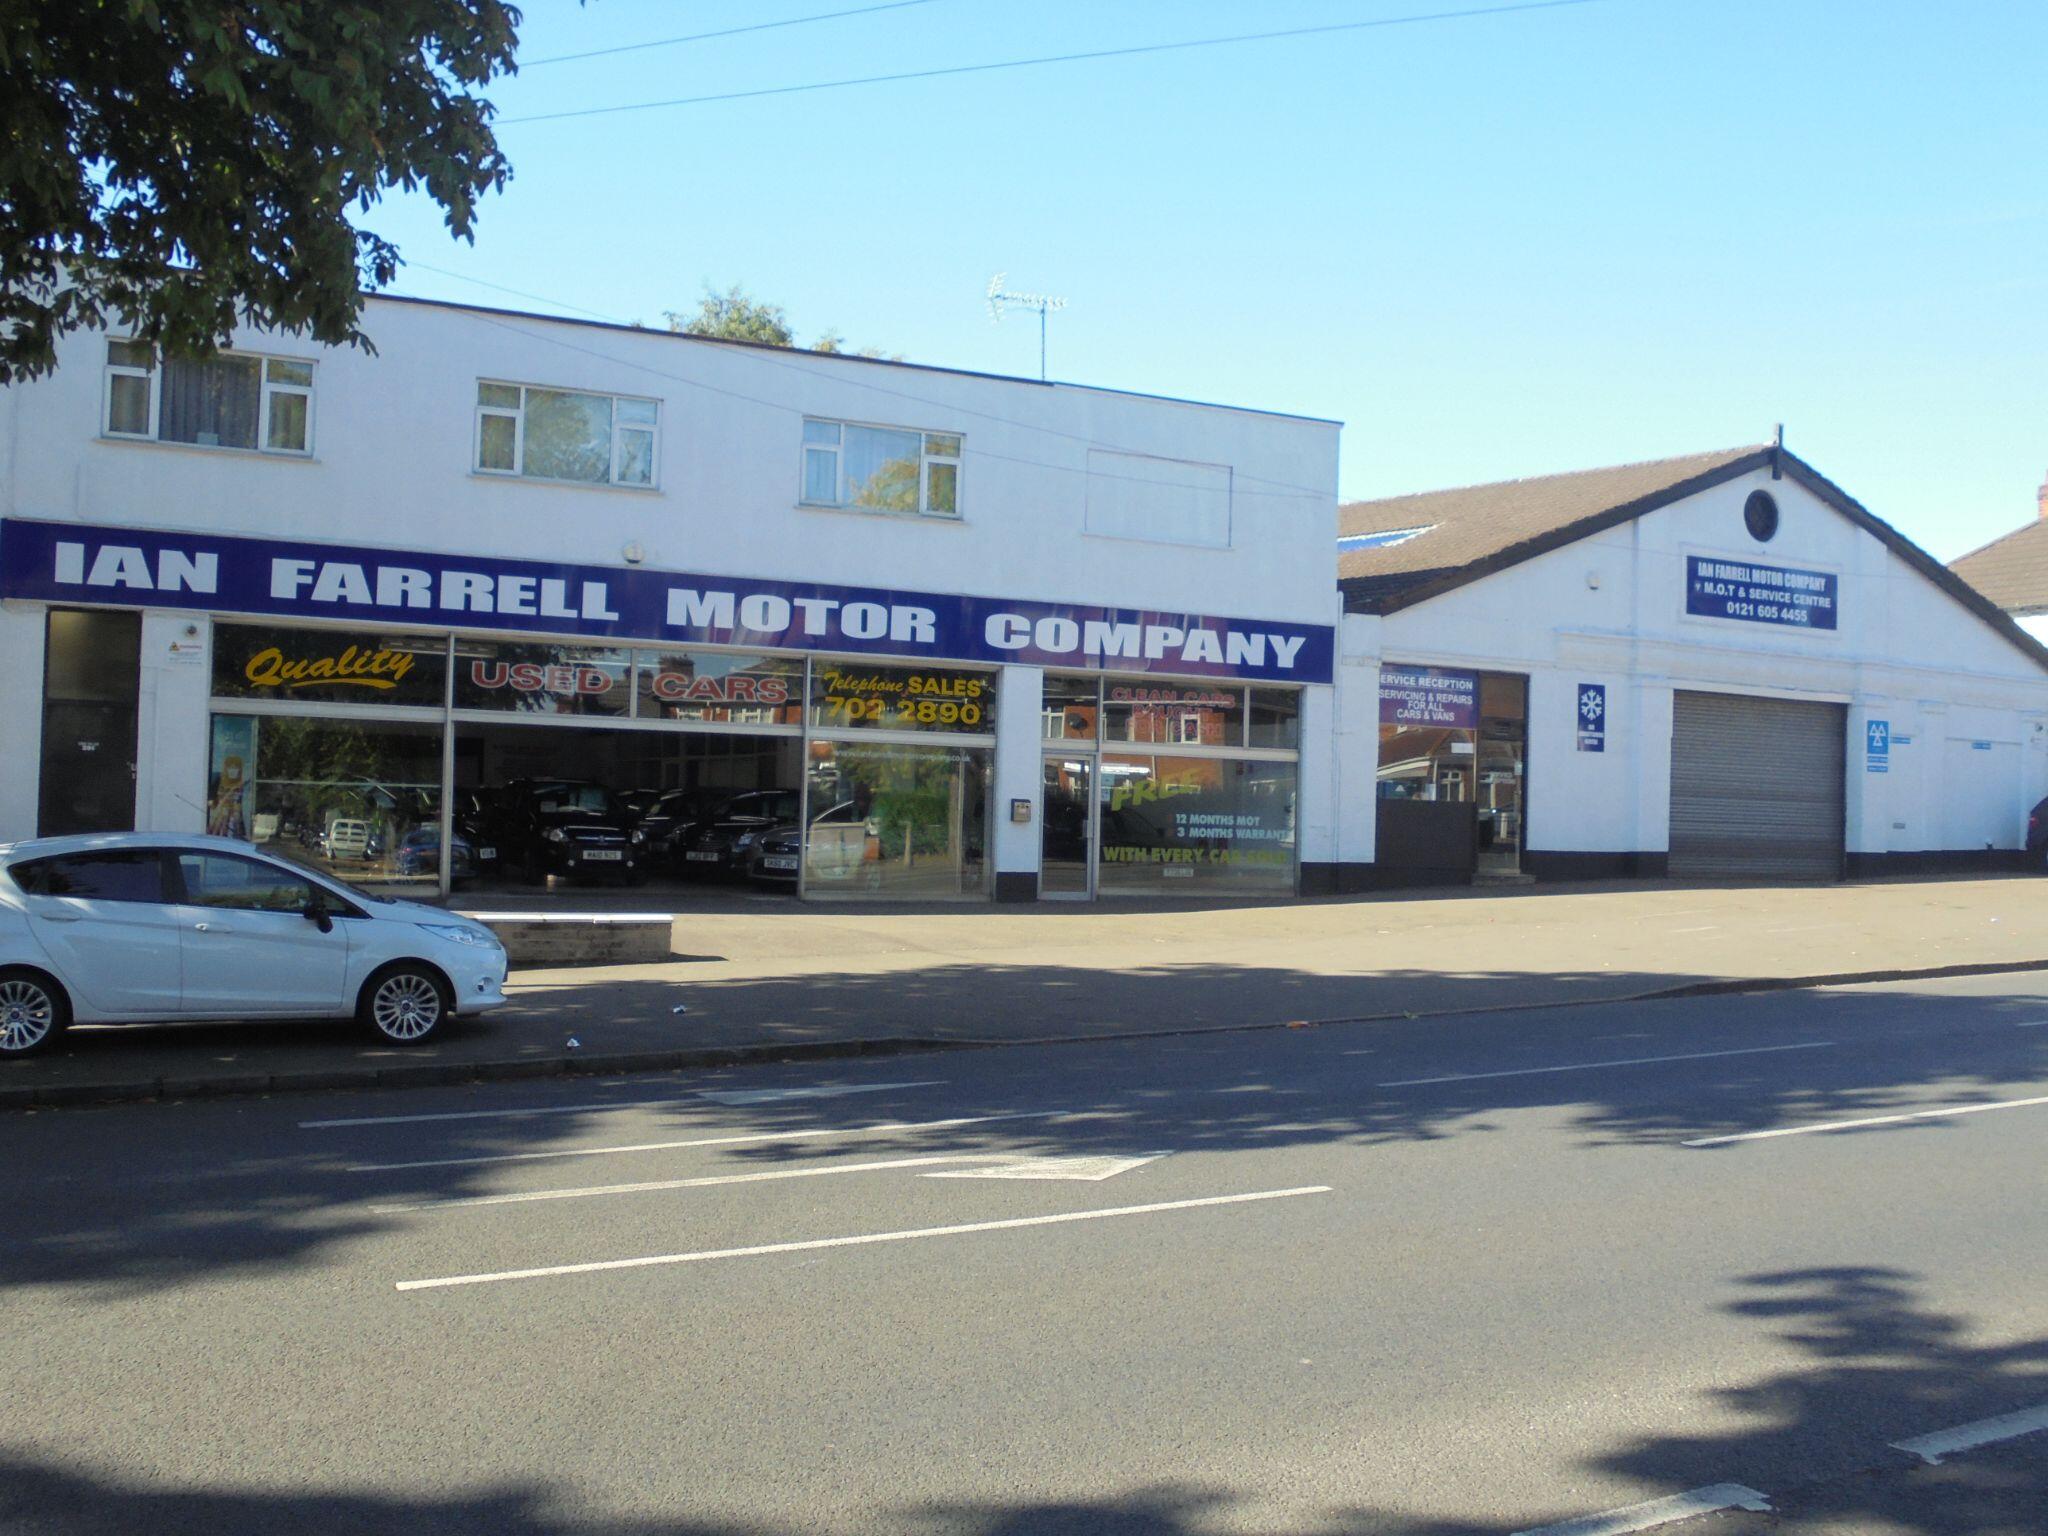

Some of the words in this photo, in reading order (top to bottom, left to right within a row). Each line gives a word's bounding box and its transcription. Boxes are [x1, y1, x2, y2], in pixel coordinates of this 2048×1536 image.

[1698, 561, 1714, 578] IAN
[1715, 564, 1751, 582] FARRELL
[1752, 569, 1783, 586] MOTOR
[1784, 573, 1826, 592] COMPANY
[54, 541, 219, 594] IAN
[270, 557, 620, 622] FARRELL
[665, 587, 937, 644] MOTOR
[983, 613, 1307, 669] COMPANY
[1738, 587, 1745, 598] &
[1749, 588, 1791, 603] SERVICE
[1793, 593, 1831, 608] CENTRE
[1727, 601, 1754, 616] 0121
[1758, 605, 1778, 619] 605
[1781, 607, 1808, 622] 4455
[245, 645, 415, 689] Quality
[471, 660, 614, 694] USED
[652, 672, 788, 705] CARS
[824, 671, 904, 694] Telephone
[908, 676, 981, 698] SALES
[1418, 676, 1473, 690] RECEPTION
[1111, 687, 1177, 703] CLEAN
[1183, 691, 1236, 709] CARS
[1379, 689, 1426, 701] SERVICING
[1428, 693, 1435, 703] &
[1436, 692, 1473, 705] REPAIRS
[1408, 700, 1426, 710] FOR
[1428, 701, 1445, 712] ALL
[825, 696, 886, 720] 702
[896, 700, 982, 725] 2890
[1397, 709, 1422, 719] CARS
[1423, 711, 1430, 720] &
[1432, 711, 1455, 722] VANS
[1176, 814, 1186, 824] 12
[1189, 814, 1234, 826] MONTHS
[1236, 816, 1260, 826] MOT
[1177, 827, 1185, 837] 3
[1189, 828, 1234, 838] MONTHS
[1103, 847, 1149, 862] WITH
[1151, 848, 1204, 864] EVERY
